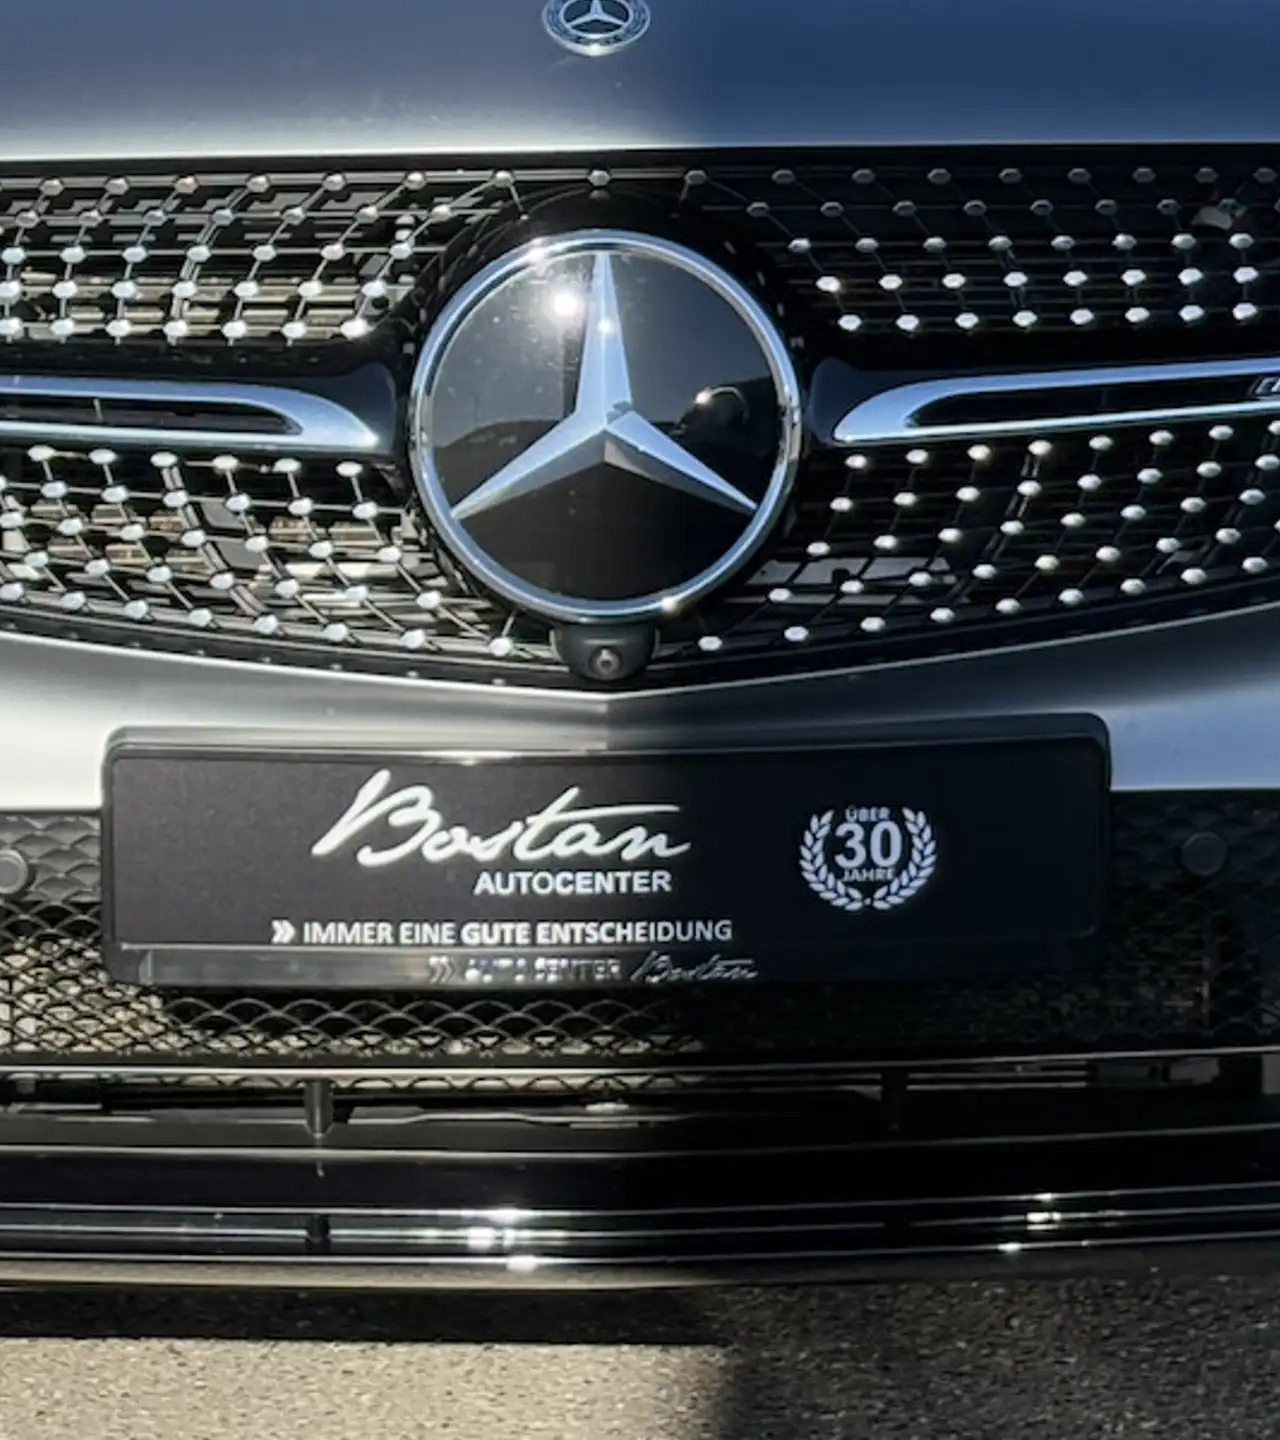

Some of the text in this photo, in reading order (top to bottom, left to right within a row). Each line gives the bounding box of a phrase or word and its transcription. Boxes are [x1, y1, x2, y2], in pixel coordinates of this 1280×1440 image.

[312, 768, 692, 867] Bostan
[844, 805, 891, 822] ÜBER
[834, 820, 902, 868] 30
[473, 869, 673, 895] AUTOCENTER
[841, 868, 896, 882] JAHRE
[303, 919, 734, 945] IMMER EINE GUTE ENTSCHEIDUNG
